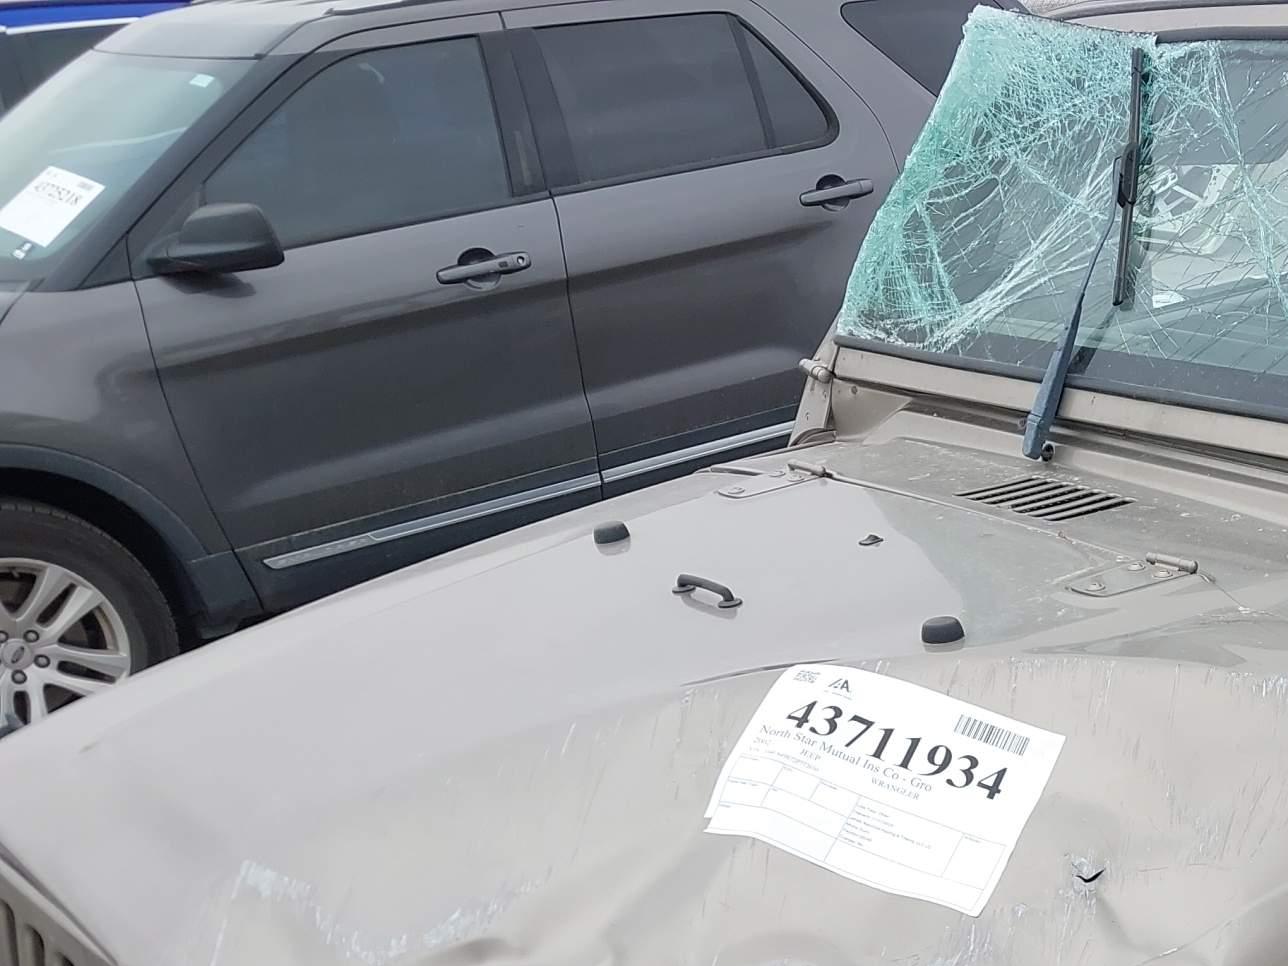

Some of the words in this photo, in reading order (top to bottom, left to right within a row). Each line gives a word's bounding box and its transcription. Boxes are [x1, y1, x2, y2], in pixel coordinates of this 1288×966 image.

[760, 724, 792, 741] North
[793, 732, 818, 747] Star
[820, 740, 862, 766] Mutual
[862, 757, 880, 774] Ins
[883, 763, 901, 780] Co
[909, 771, 933, 793] Gro
[786, 699, 1008, 800] 43711934
[870, 776, 921, 802] WRANGLER
